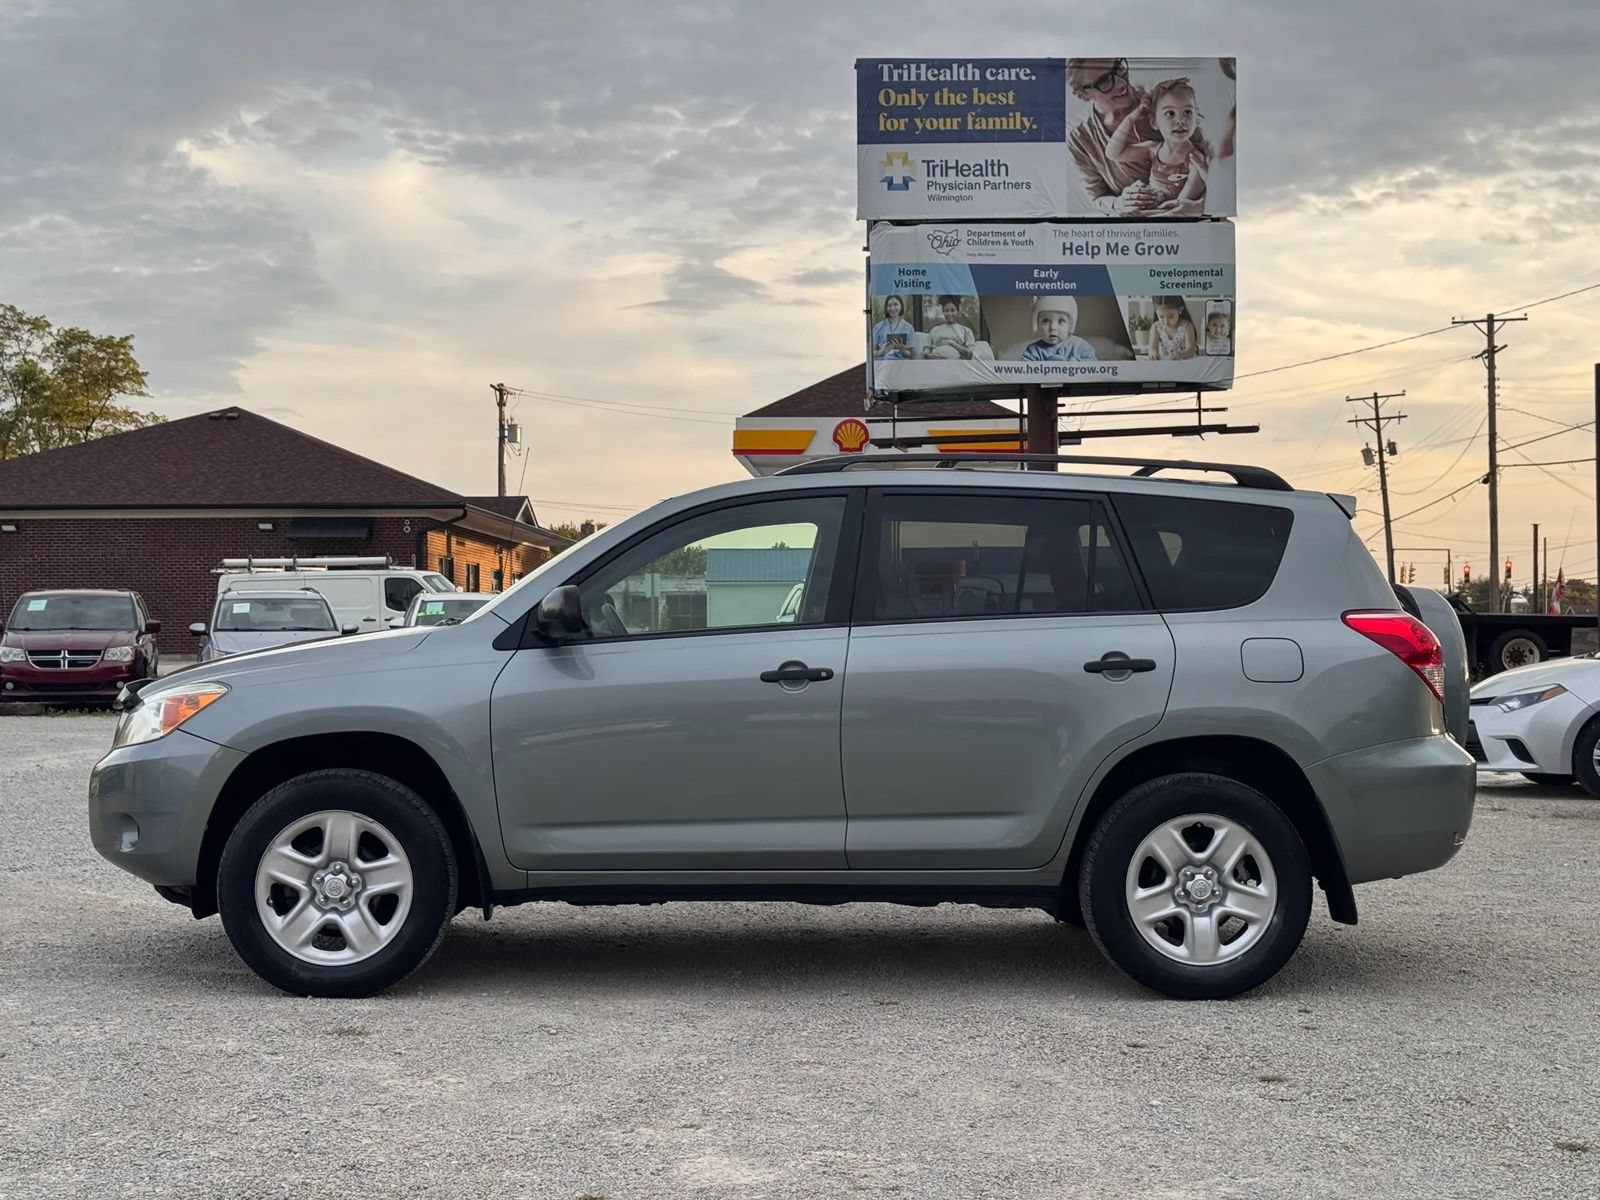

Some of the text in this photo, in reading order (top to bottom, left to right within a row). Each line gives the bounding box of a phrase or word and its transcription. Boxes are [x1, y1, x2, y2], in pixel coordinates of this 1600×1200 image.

[878, 63, 1037, 82] TriHealth care.
[878, 87, 1016, 110] Only the best
[878, 112, 1037, 134] for your family.
[921, 159, 1009, 178] TriHealth
[927, 180, 1032, 193] Physician Partners
[927, 194, 973, 203] Wilmington
[966, 229, 1026, 239] Department of
[1053, 228, 1180, 240] The heart of thriving families.
[927, 233, 962, 250] Ohio
[966, 238, 1034, 247] Children & Youth
[1062, 241, 1180, 259] Help Me Grow
[898, 268, 927, 277] Home
[1033, 269, 1059, 280] Early
[1150, 268, 1223, 279] Developmental
[894, 280, 931, 290] Visiting
[1015, 280, 1077, 290] Intervention
[1159, 280, 1213, 291] Screenings
[994, 364, 1119, 377] www.helpmegrow.org
